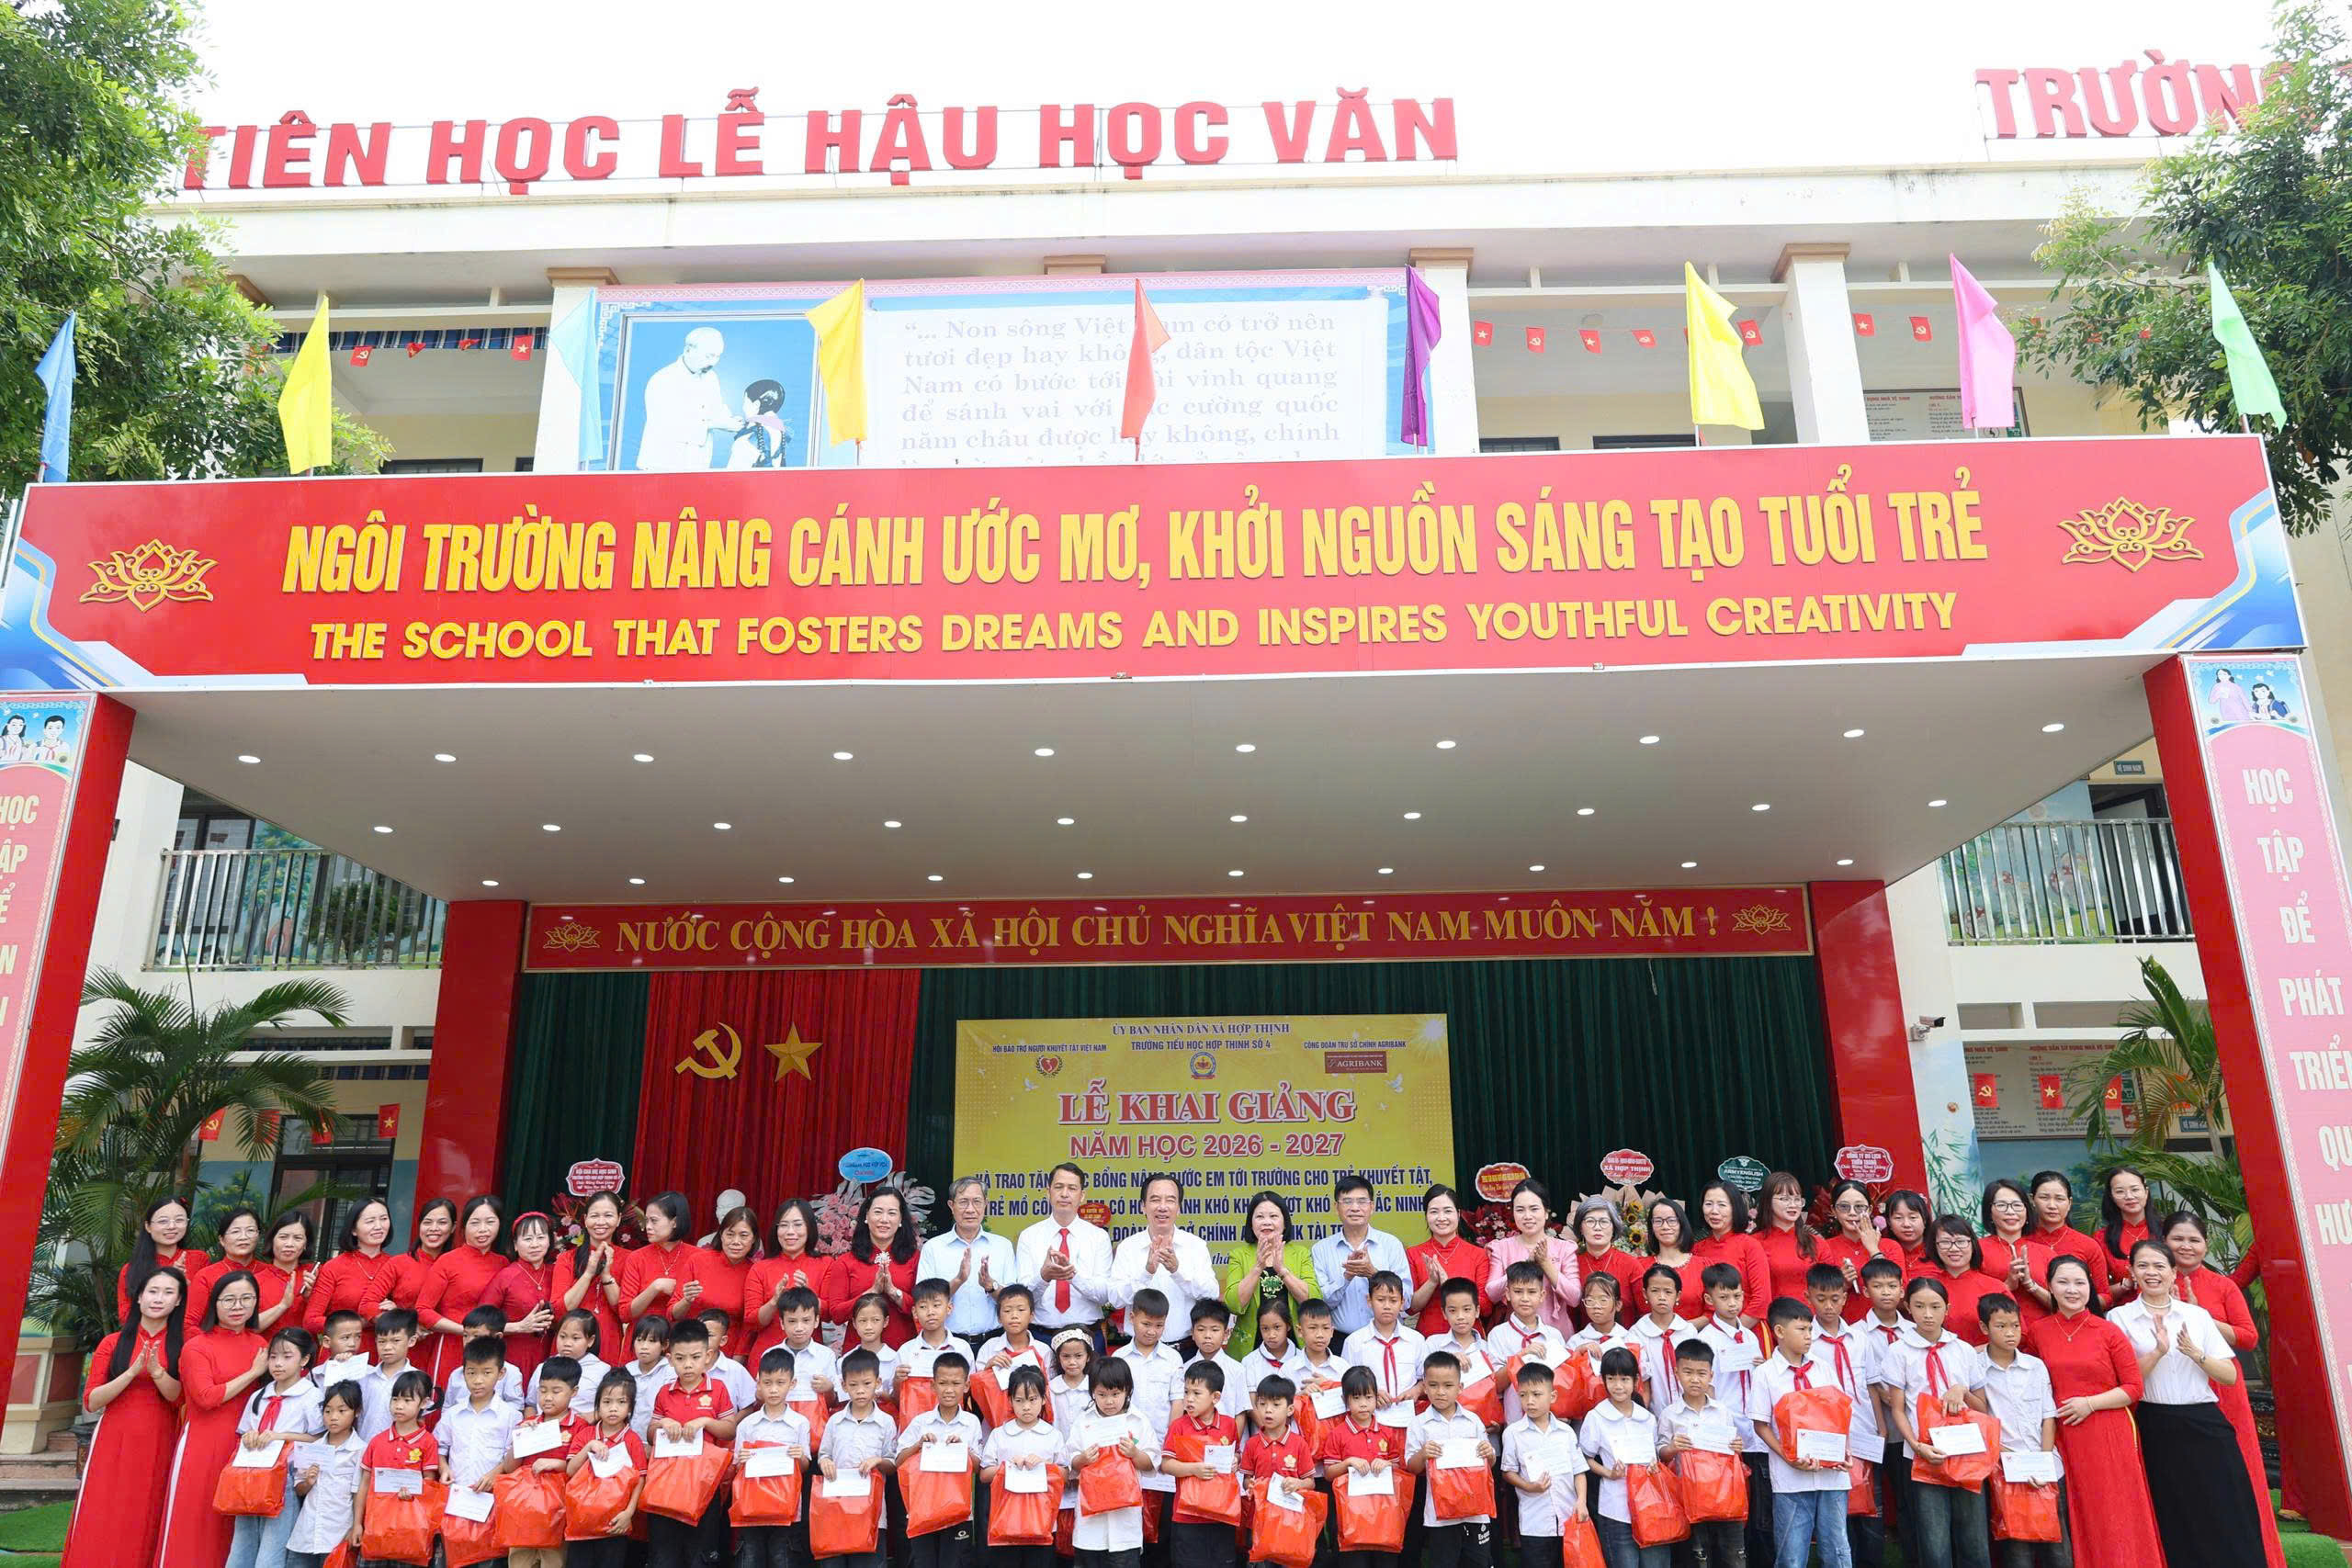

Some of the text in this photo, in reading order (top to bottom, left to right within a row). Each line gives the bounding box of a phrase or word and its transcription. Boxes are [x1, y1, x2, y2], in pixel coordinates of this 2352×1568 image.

[427, 116, 619, 195] HỌC
[659, 86, 764, 178] LỄ
[805, 94, 997, 186] HẬU
[1039, 101, 1228, 180] HỌC
[1262, 86, 1458, 163] VĂN
[946, 321, 997, 338] Non
[1007, 319, 1066, 339] sông
[1075, 317, 1125, 339] Việt
[1204, 315, 1231, 333] có
[1242, 311, 1279, 332] trở
[1288, 312, 1335, 331] nên
[905, 348, 955, 367] tươi
[966, 347, 1012, 369] đẹp
[1023, 346, 1069, 367] hay
[1177, 342, 1224, 360] dân
[1235, 342, 1273, 363] tộc
[1283, 340, 1338, 362] Việt
[903, 376, 963, 395] Nam
[974, 375, 1002, 392] có
[1014, 372, 1077, 392] bước
[1088, 371, 1122, 389] tới
[1186, 368, 1245, 388] vinh
[1256, 371, 1338, 394] quang
[902, 399, 934, 422] để
[946, 402, 1007, 421] sánh
[1022, 400, 1059, 419] vai
[1075, 399, 1113, 417] với
[1183, 396, 1263, 417] cường
[1276, 391, 1339, 416] quốc
[902, 431, 956, 450] năm
[967, 430, 1029, 448] châu
[1038, 427, 1101, 451] được
[1167, 424, 1256, 446] không,
[1264, 422, 1340, 442] chính
[282, 464, 1988, 592] NGÔI TRƯỜNG NÂNG CÁNH ƯỚC MƠ, KHỞI NGUỒN SÁNG TẠO TUỔI TRẺ
[311, 592, 1956, 660] THE SCHOOL THAT FOSTERS DREAMS AND INSPIRES YOUTHFUL CREATIVITY
[2243, 768, 2293, 812] HỌC
[0, 838, 28, 879] ẬP
[2256, 829, 2304, 881] TẬP
[616, 899, 1717, 959] NƯỚC CỘNG HÒA XÃ HỘI CHỦ NGHĨA VIỆT NAM MUÔN NĂM !
[2279, 890, 2315, 944] ĐỂ
[2278, 969, 2345, 1016] PHÁT
[1129, 1025, 1150, 1035] BAN
[1154, 1022, 1183, 1034] NHÂN
[1187, 1022, 1208, 1034] DÂN
[1212, 1021, 1225, 1034] XÃ
[1228, 1022, 1250, 1036] HỢP
[1255, 1023, 1290, 1036] THỊNH
[1132, 1039, 1164, 1050] TRƯỜNG
[1167, 1037, 1183, 1049] TIỂU
[1265, 1040, 1271, 1048] 4
[1337, 1059, 1383, 1067] AGRIBANK
[2290, 1033, 2352, 1090] TRIỂ
[1058, 1078, 1355, 1124] LỄ KHAI GIẢNG
[1070, 1131, 1129, 1159] NĂM
[1137, 1134, 1195, 1162] HỌC
[1203, 1134, 1262, 1156] 2026
[1285, 1133, 1345, 1156] 2027
[995, 1173, 1025, 1189] TRAO
[1029, 1169, 1050, 1191] TẶN
[1093, 1167, 1126, 1188] BỔNG
[1205, 1171, 1225, 1186] EM
[1228, 1168, 1247, 1187] TỚI
[1251, 1168, 1300, 1186] TRƯỜNG
[1305, 1170, 1329, 1185] CHO
[1409, 1166, 1432, 1188] TẬT,
[1009, 1195, 1028, 1215] MỒ
[1109, 1197, 1125, 1214] CÓ
[1204, 1195, 1229, 1213] KHÓ
[1306, 1194, 1330, 1213] KHÓ
[1375, 1190, 1391, 1212] ẮC
[1396, 1196, 1426, 1212] NINH
[1199, 1222, 1237, 1241] CHÍNH
[1307, 1222, 1327, 1240] TÀI
